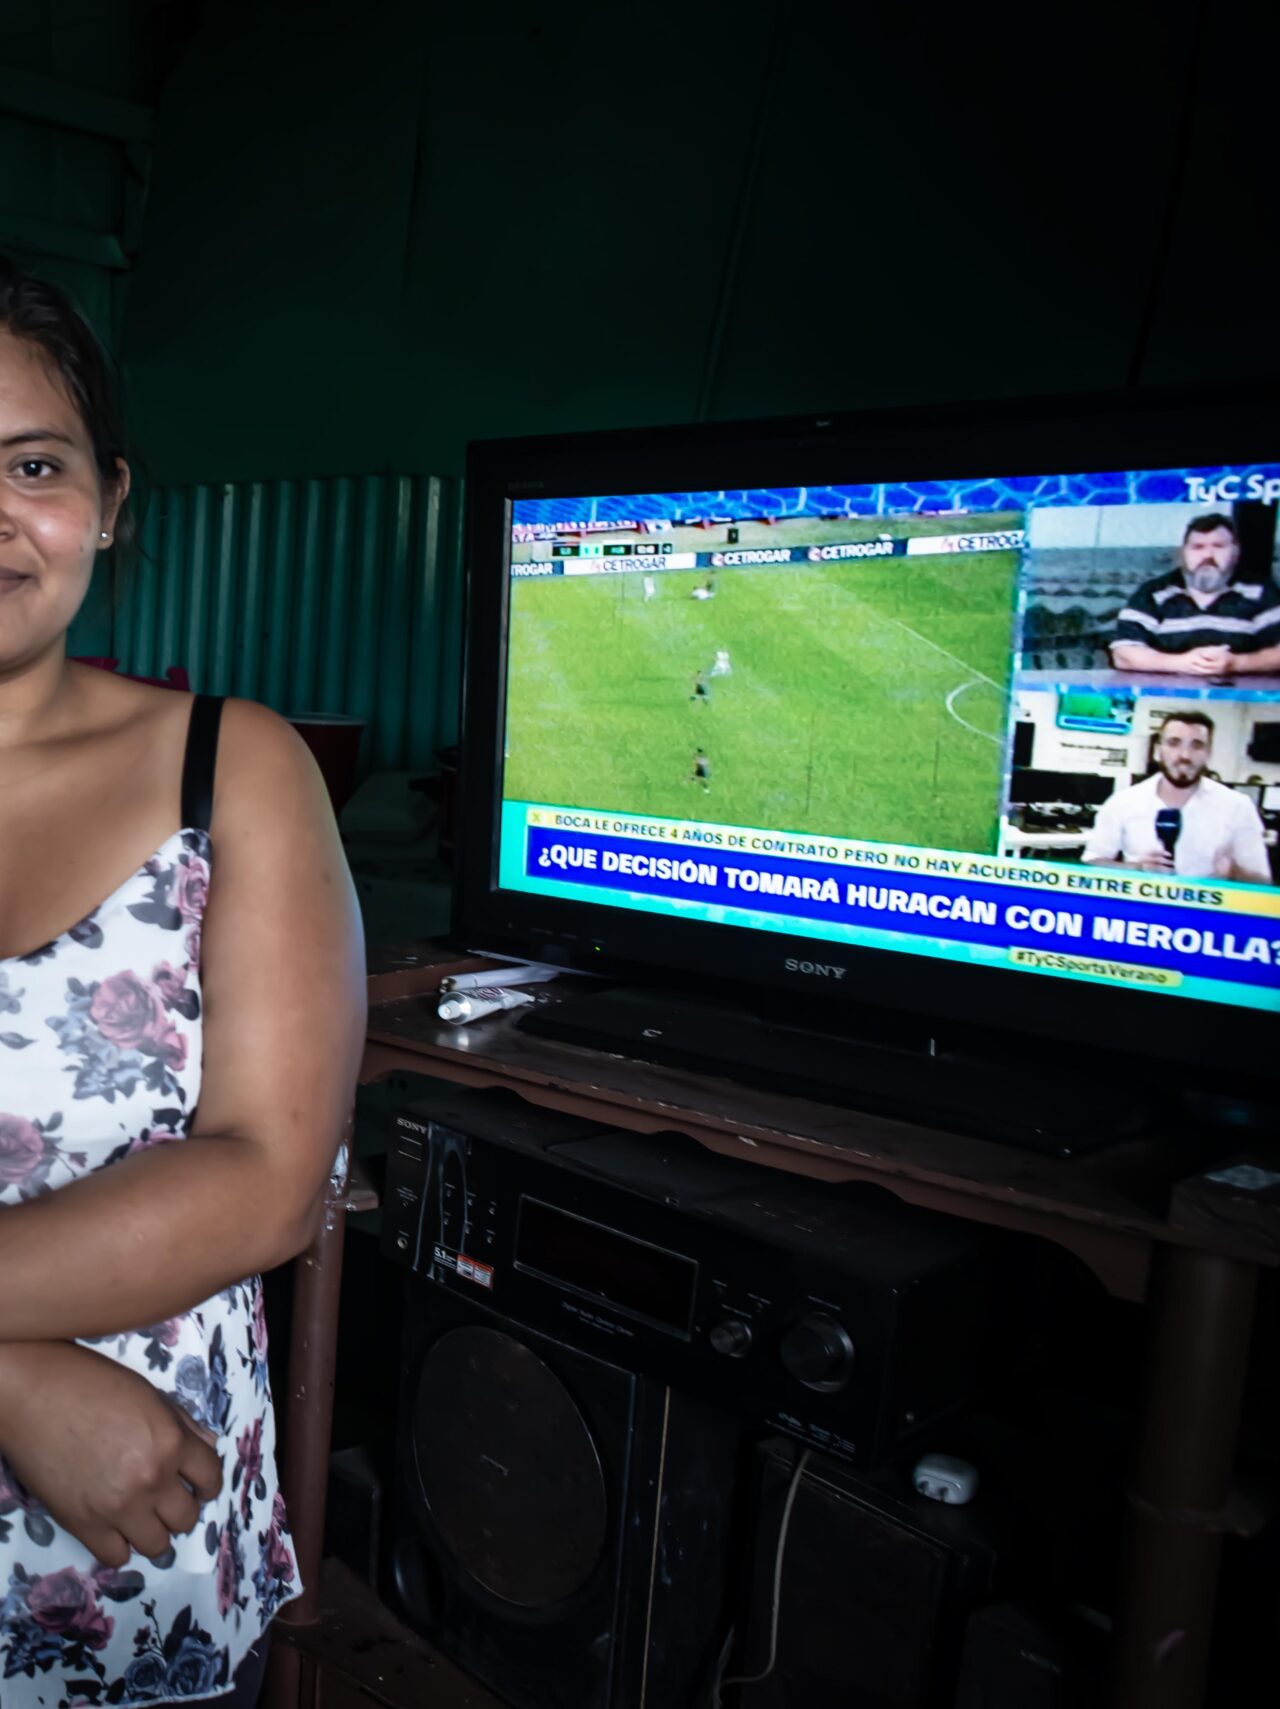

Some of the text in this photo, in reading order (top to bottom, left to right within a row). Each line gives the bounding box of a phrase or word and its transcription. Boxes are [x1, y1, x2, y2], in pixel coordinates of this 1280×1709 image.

[1184, 475, 1242, 507] TyC
[723, 548, 791, 566] CETROGAR
[821, 541, 893, 560] CETROGAR
[603, 556, 667, 572] CETROGAR
[555, 814, 1224, 906] BOCA LE OFRECE 4 AÑOS DE CONTRATO PERO NO HAY ACUERDO ENTRE CLUBES
[538, 844, 597, 870] ¿QUE
[602, 851, 718, 886] DECISIÓN
[723, 867, 840, 904] TOMARÁ
[846, 883, 998, 925] HURACÁN
[1004, 905, 1083, 938] CON
[784, 958, 848, 980] SONY
[1016, 950, 1168, 984] #TyCSportsVerano
[396, 1116, 428, 1135] SONY
